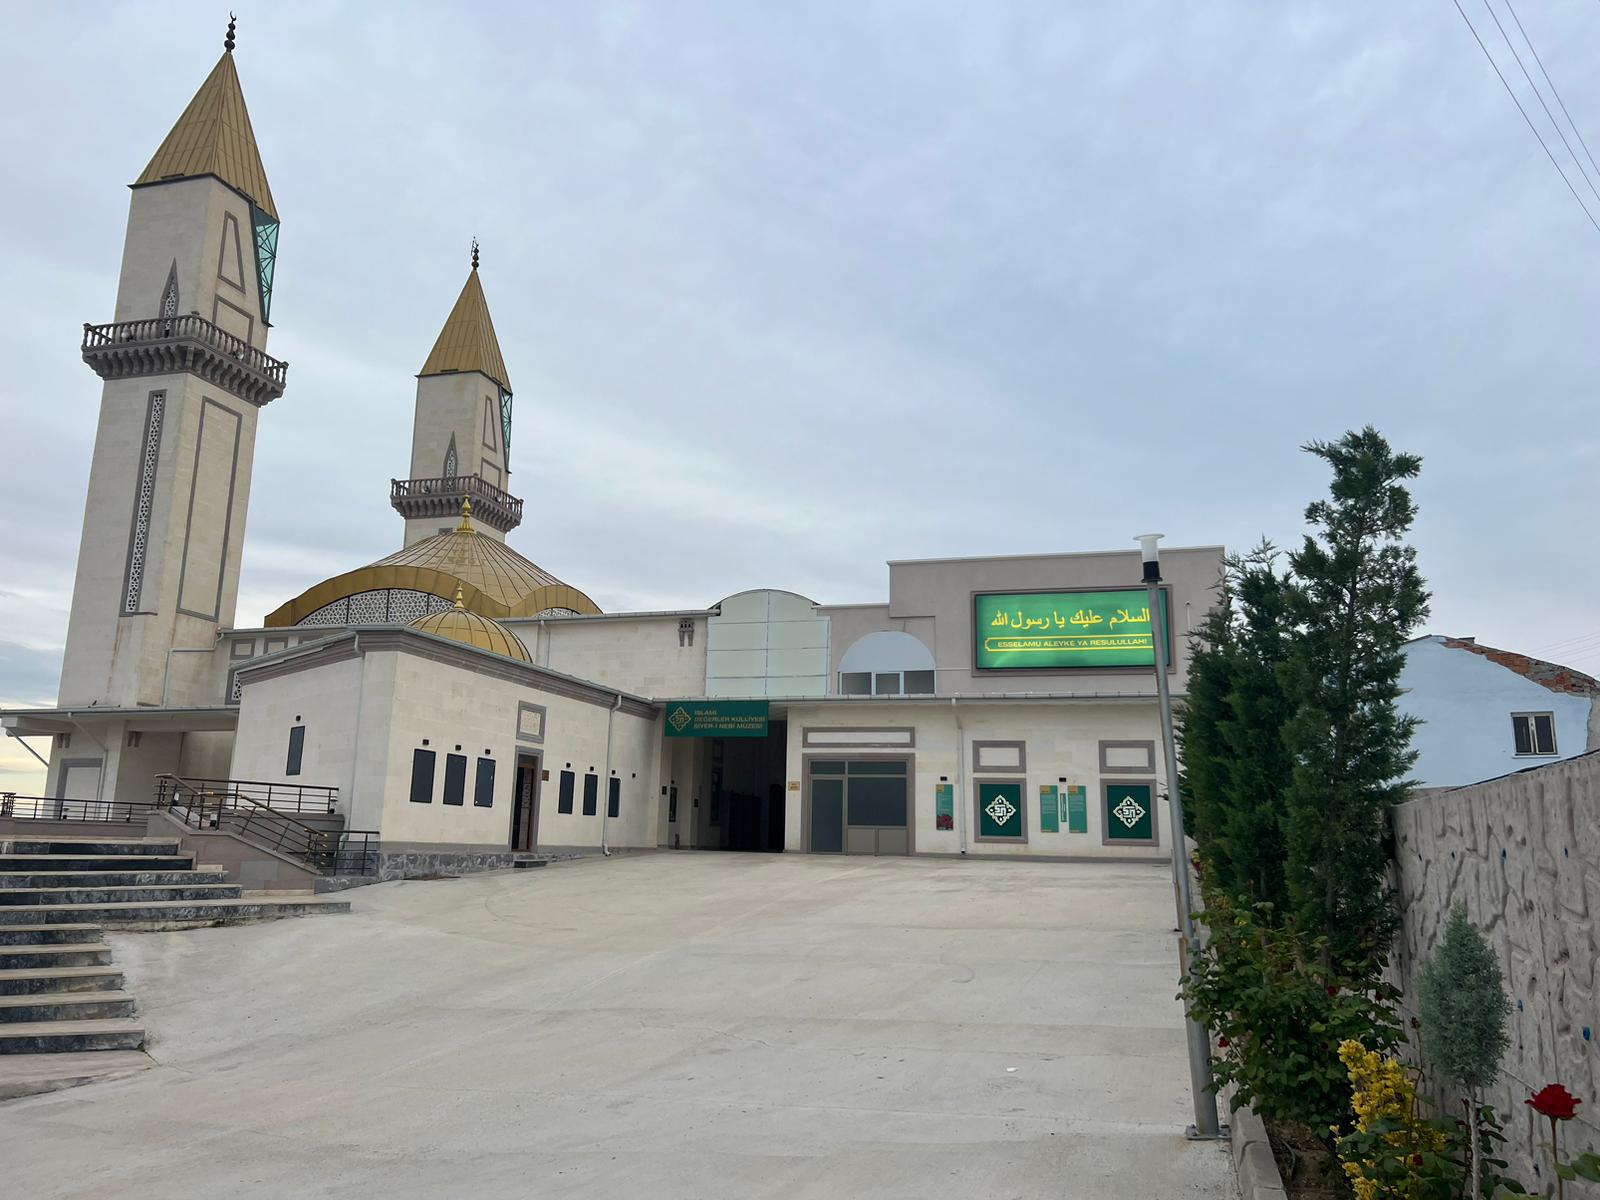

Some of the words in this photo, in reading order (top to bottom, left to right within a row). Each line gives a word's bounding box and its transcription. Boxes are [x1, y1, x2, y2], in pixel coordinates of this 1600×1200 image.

[992, 610, 1008, 626] الله
[1011, 610, 1050, 630] رسول
[1053, 610, 1065, 628] يا
[1070, 610, 1103, 628] عليك
[1109, 608, 1150, 630] السلام
